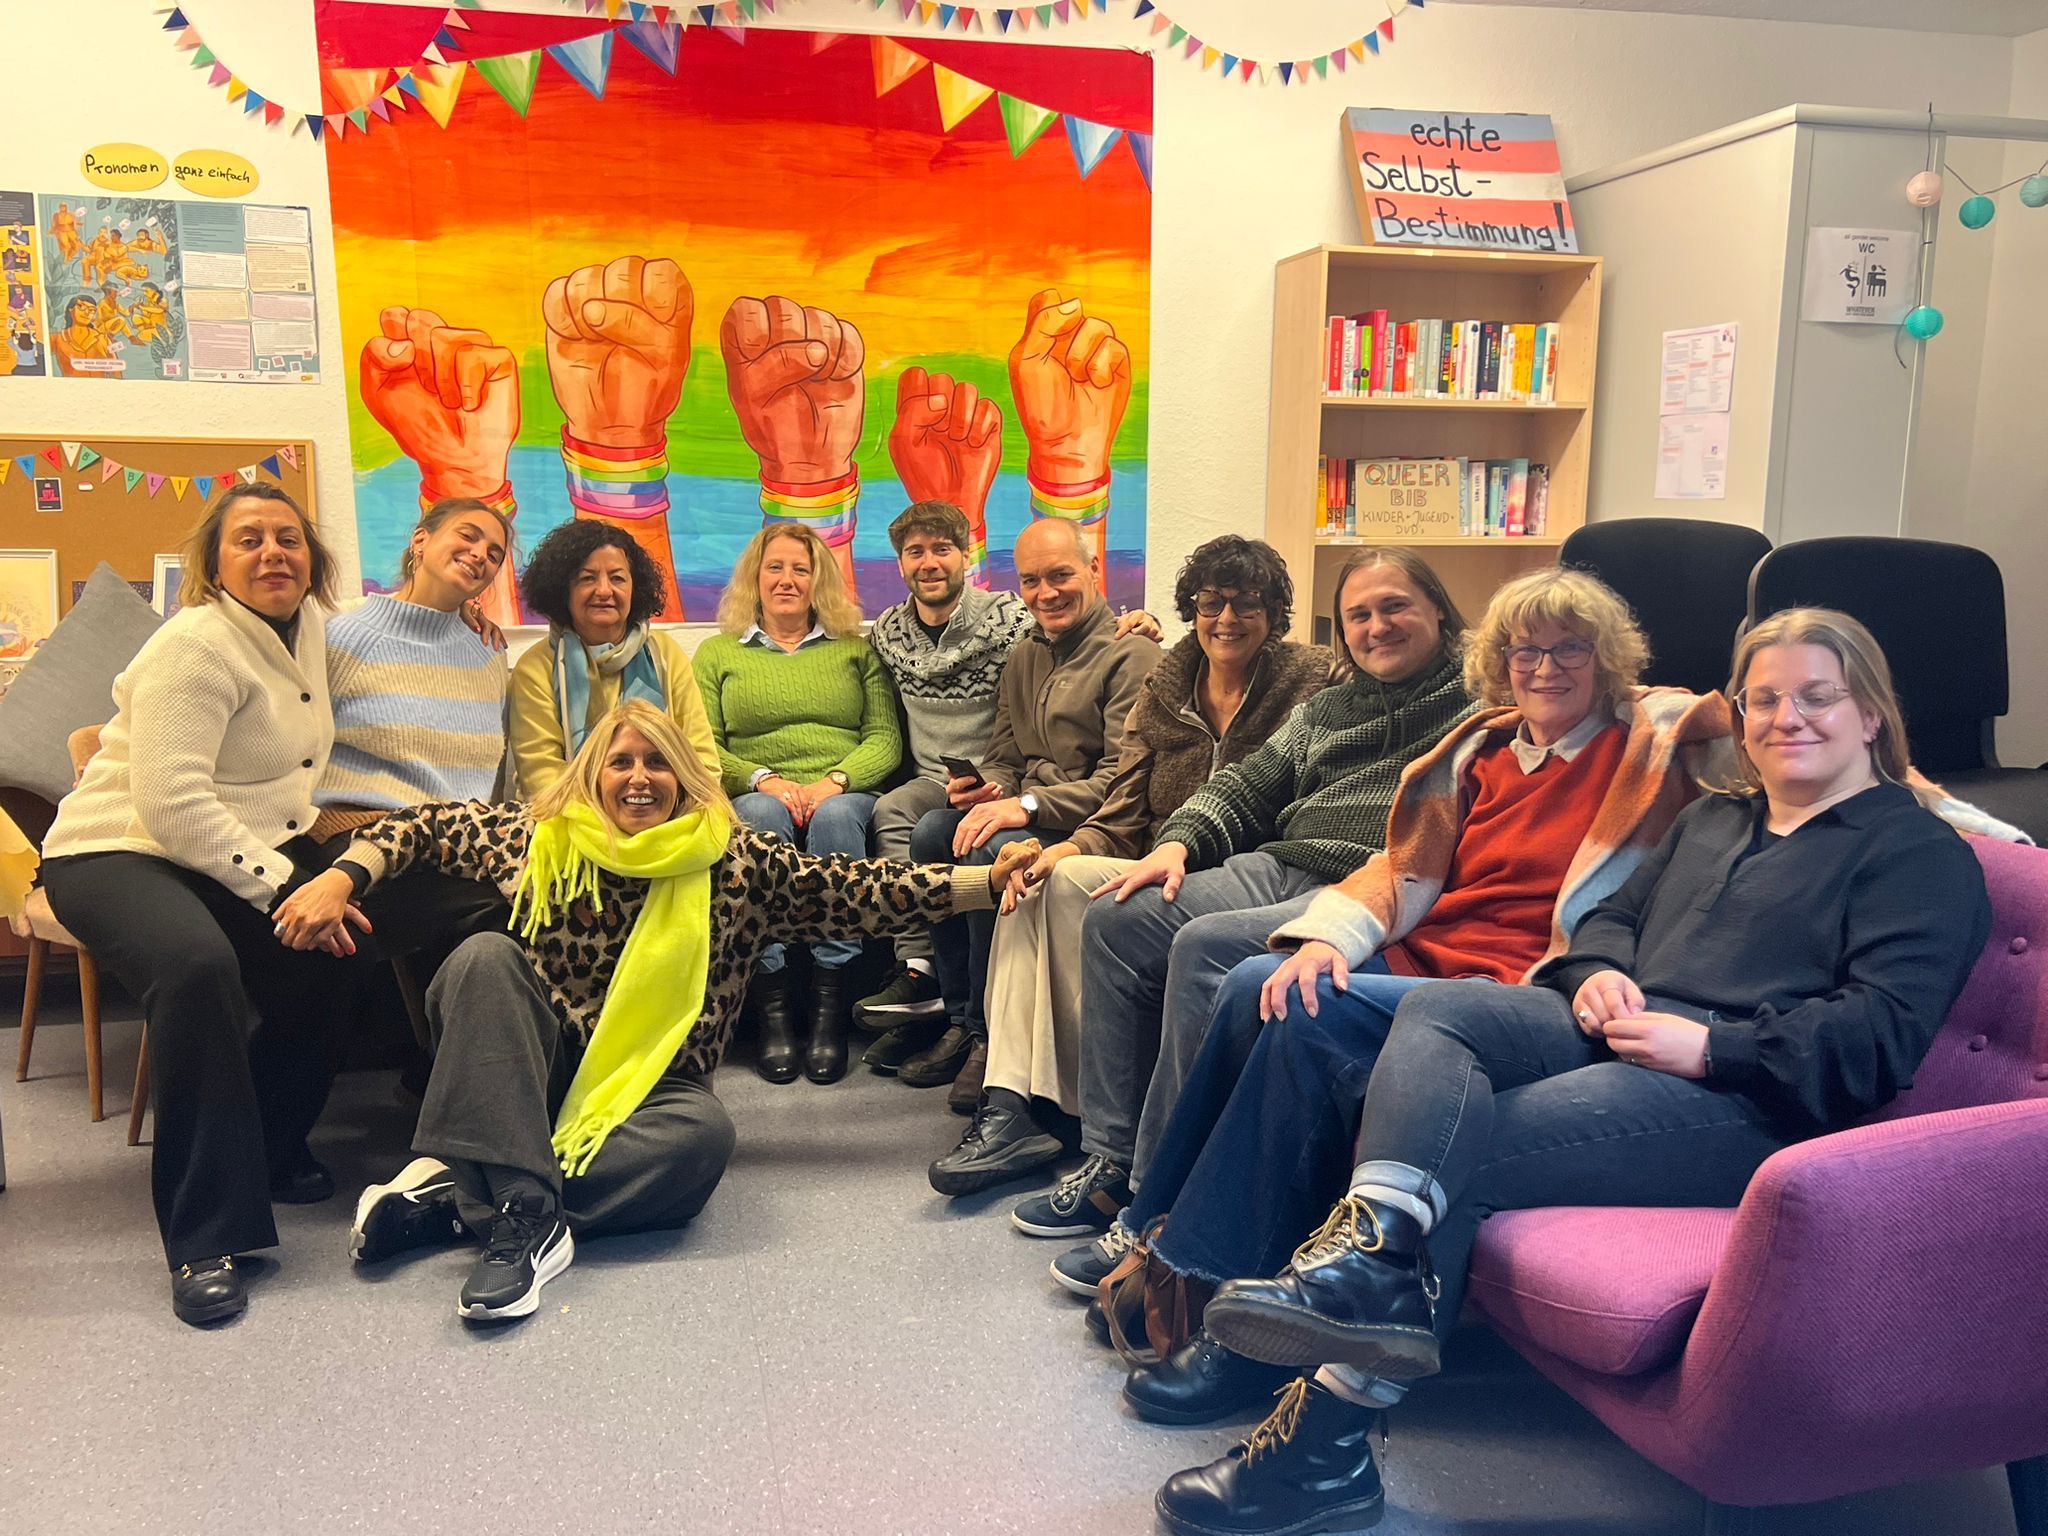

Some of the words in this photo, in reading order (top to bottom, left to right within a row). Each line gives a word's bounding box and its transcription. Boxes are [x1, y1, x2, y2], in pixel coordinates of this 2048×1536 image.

[1410, 115, 1502, 152] echte
[85, 154, 159, 174] Pronomen
[175, 166, 204, 180] ganz
[208, 167, 251, 183] einfach
[1374, 198, 1570, 250] Bestimmung!
[1858, 243, 1875, 253] WC
[1364, 463, 1451, 487] QUEER
[1390, 488, 1428, 507] BIB
